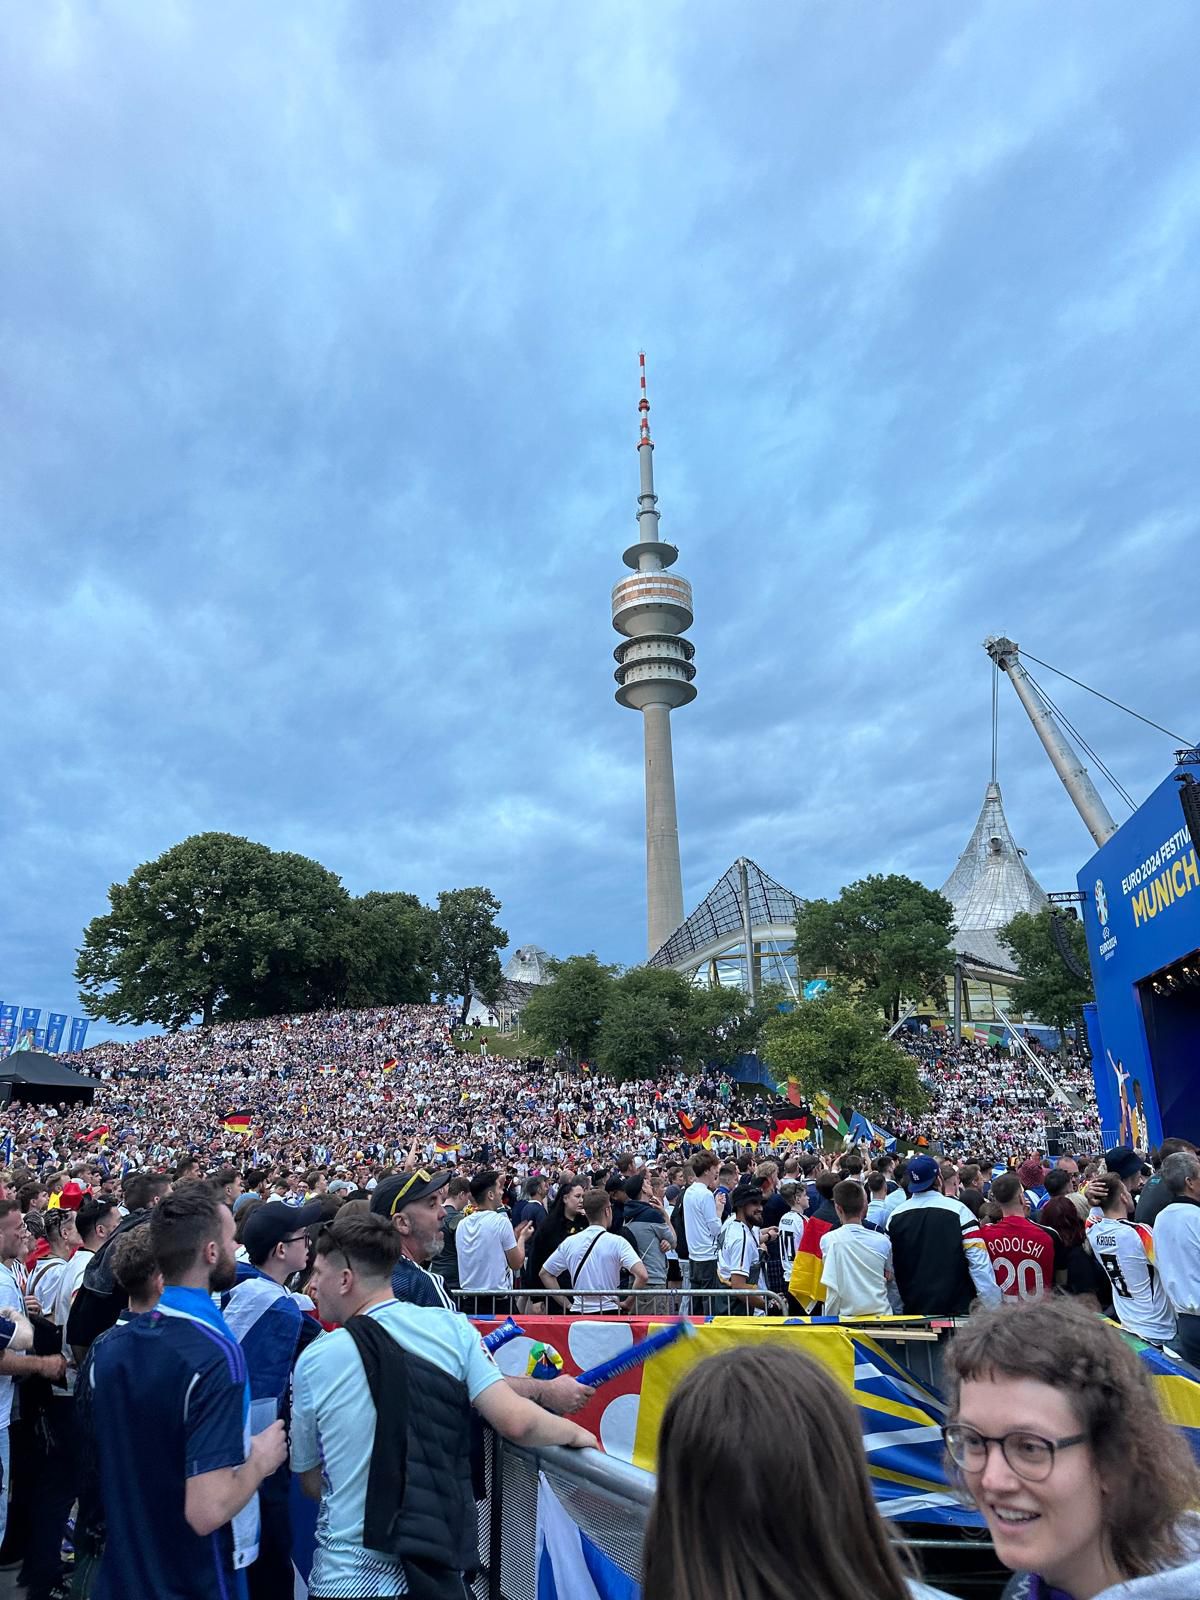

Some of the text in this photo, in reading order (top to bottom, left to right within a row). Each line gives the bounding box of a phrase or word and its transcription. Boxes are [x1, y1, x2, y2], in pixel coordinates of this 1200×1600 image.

[1121, 824, 1191, 895] EURO 2024 FESTIV
[1131, 849, 1200, 928] MUNICH
[988, 1237, 1045, 1258] PODOLSKI
[1096, 1235, 1117, 1247] KROOS
[993, 1256, 1044, 1303] 20
[1100, 1253, 1133, 1299] 8
